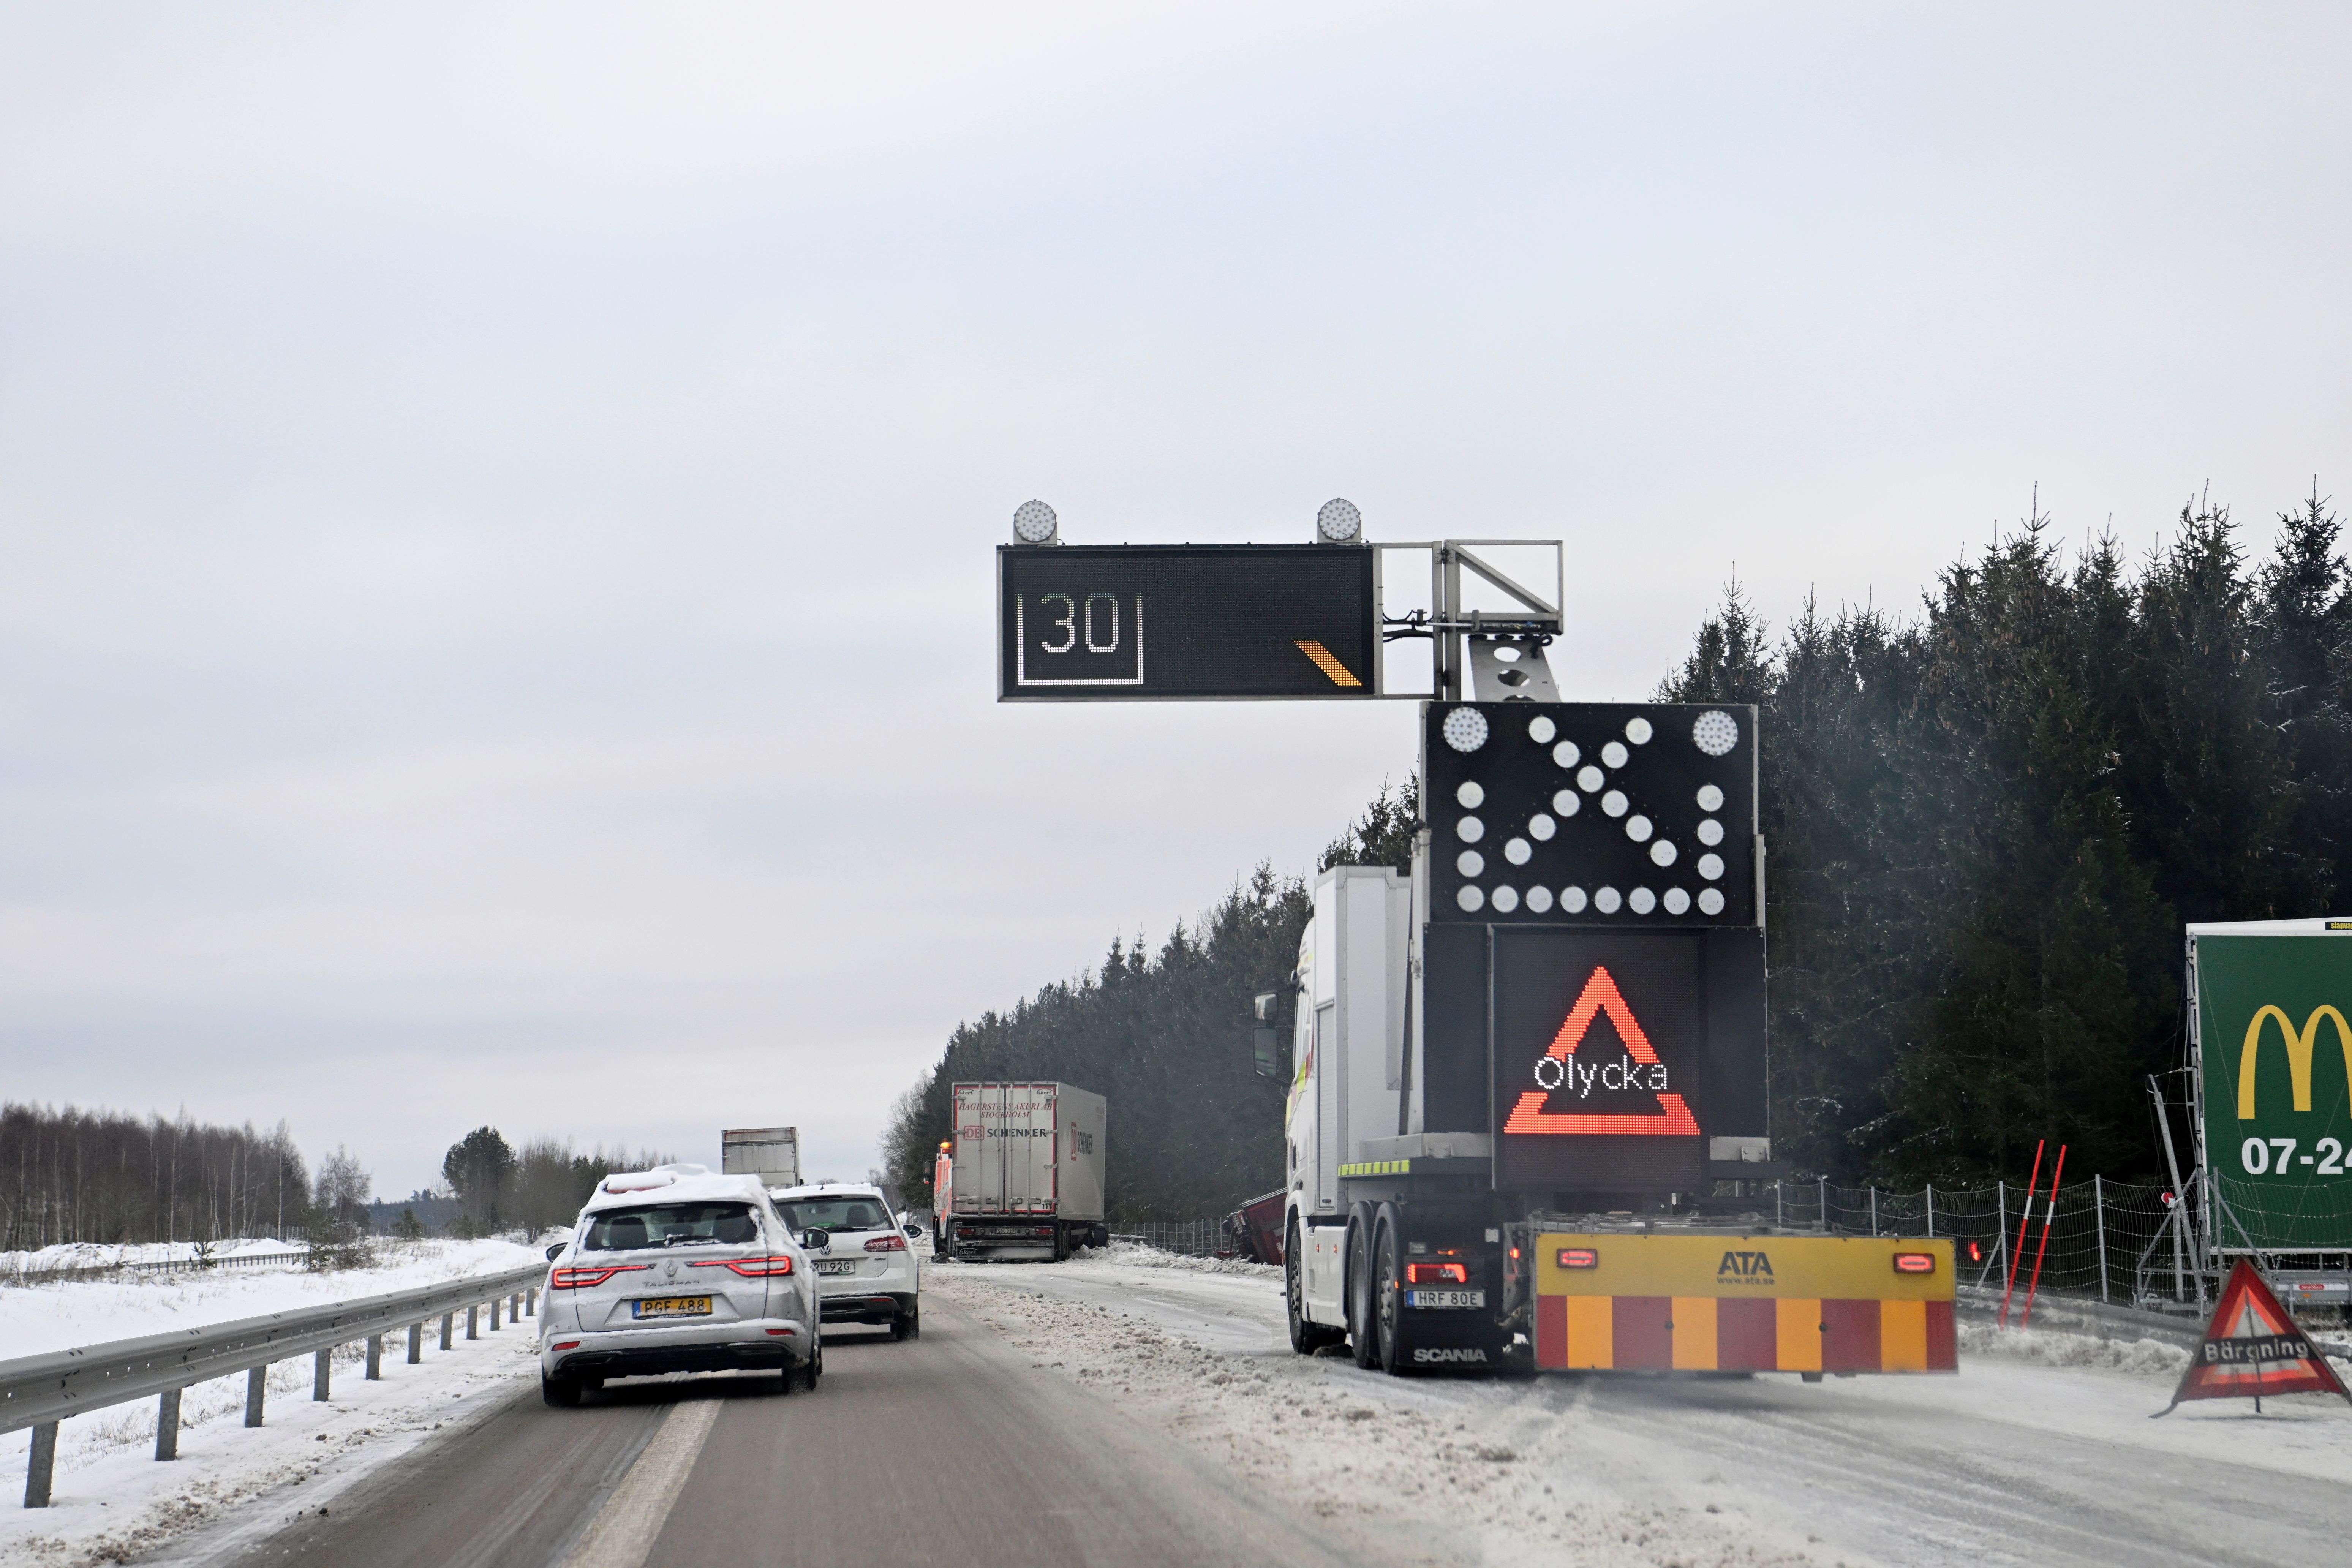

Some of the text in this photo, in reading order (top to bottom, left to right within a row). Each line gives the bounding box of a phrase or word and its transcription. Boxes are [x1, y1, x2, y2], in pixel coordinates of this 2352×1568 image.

[1042, 593, 1119, 653] 30
[1534, 1054, 1667, 1099] Olycka
[966, 1128, 1047, 1138] DB SCHENKER
[2242, 1138, 2352, 1175] 07-2
[814, 1261, 850, 1272] RU 92G
[1718, 1252, 1774, 1275] ATA
[1717, 1277, 1775, 1285] www.ata.se
[1419, 1292, 1477, 1305] HRF 80E
[645, 1299, 705, 1314] PGF 488
[1413, 1348, 1487, 1362] SCANIA
[2204, 1337, 2309, 1363] Bärgning
